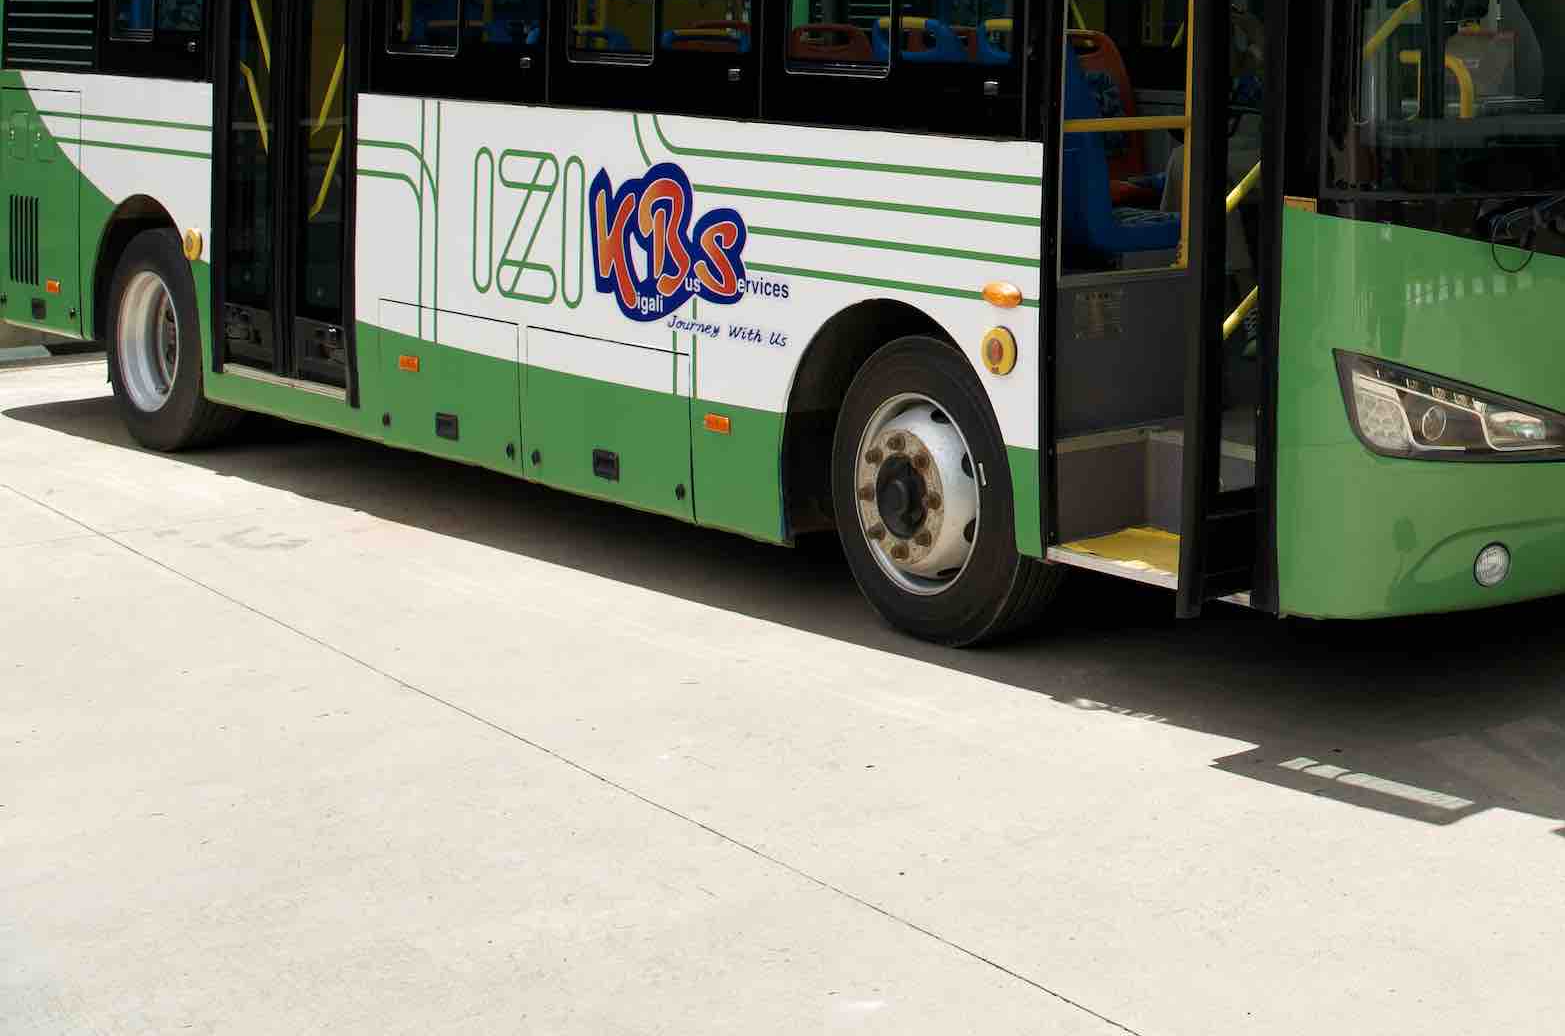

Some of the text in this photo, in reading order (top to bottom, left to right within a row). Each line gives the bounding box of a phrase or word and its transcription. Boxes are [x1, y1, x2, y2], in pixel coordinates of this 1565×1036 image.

[472, 146, 586, 309] IZI
[595, 177, 739, 310] KBS
[667, 315, 789, 346] Journey With Us
